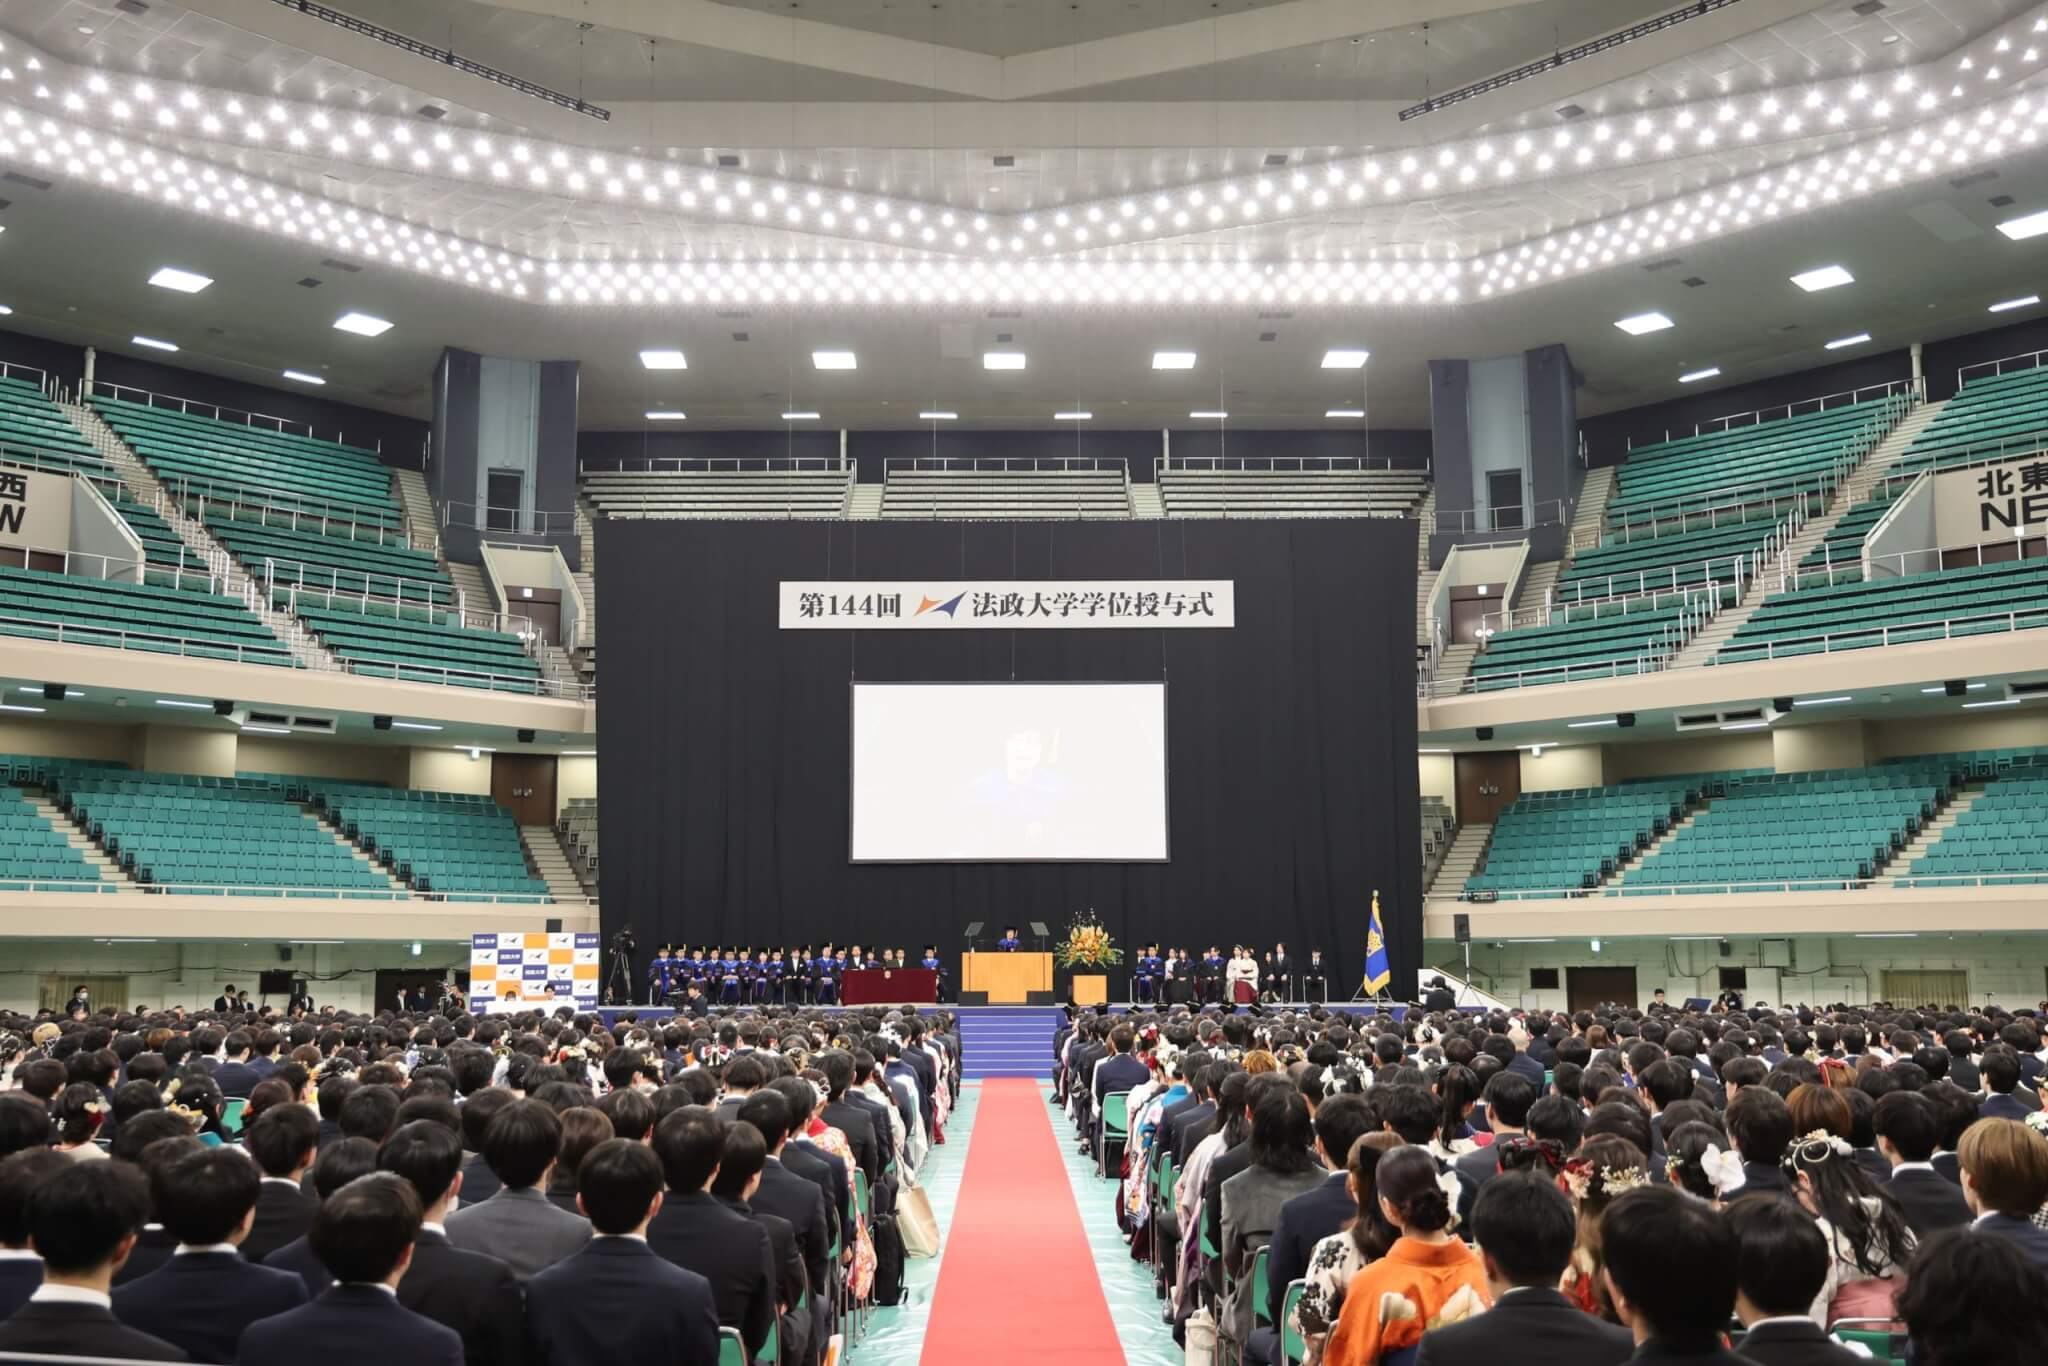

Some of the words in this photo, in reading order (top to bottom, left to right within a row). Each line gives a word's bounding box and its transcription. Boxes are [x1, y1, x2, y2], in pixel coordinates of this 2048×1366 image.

[1978, 461, 2048, 499] 北東
[1980, 493, 2048, 532] NE
[799, 592, 901, 618] 第144回
[972, 591, 1214, 617] 法政大学学位授与式
